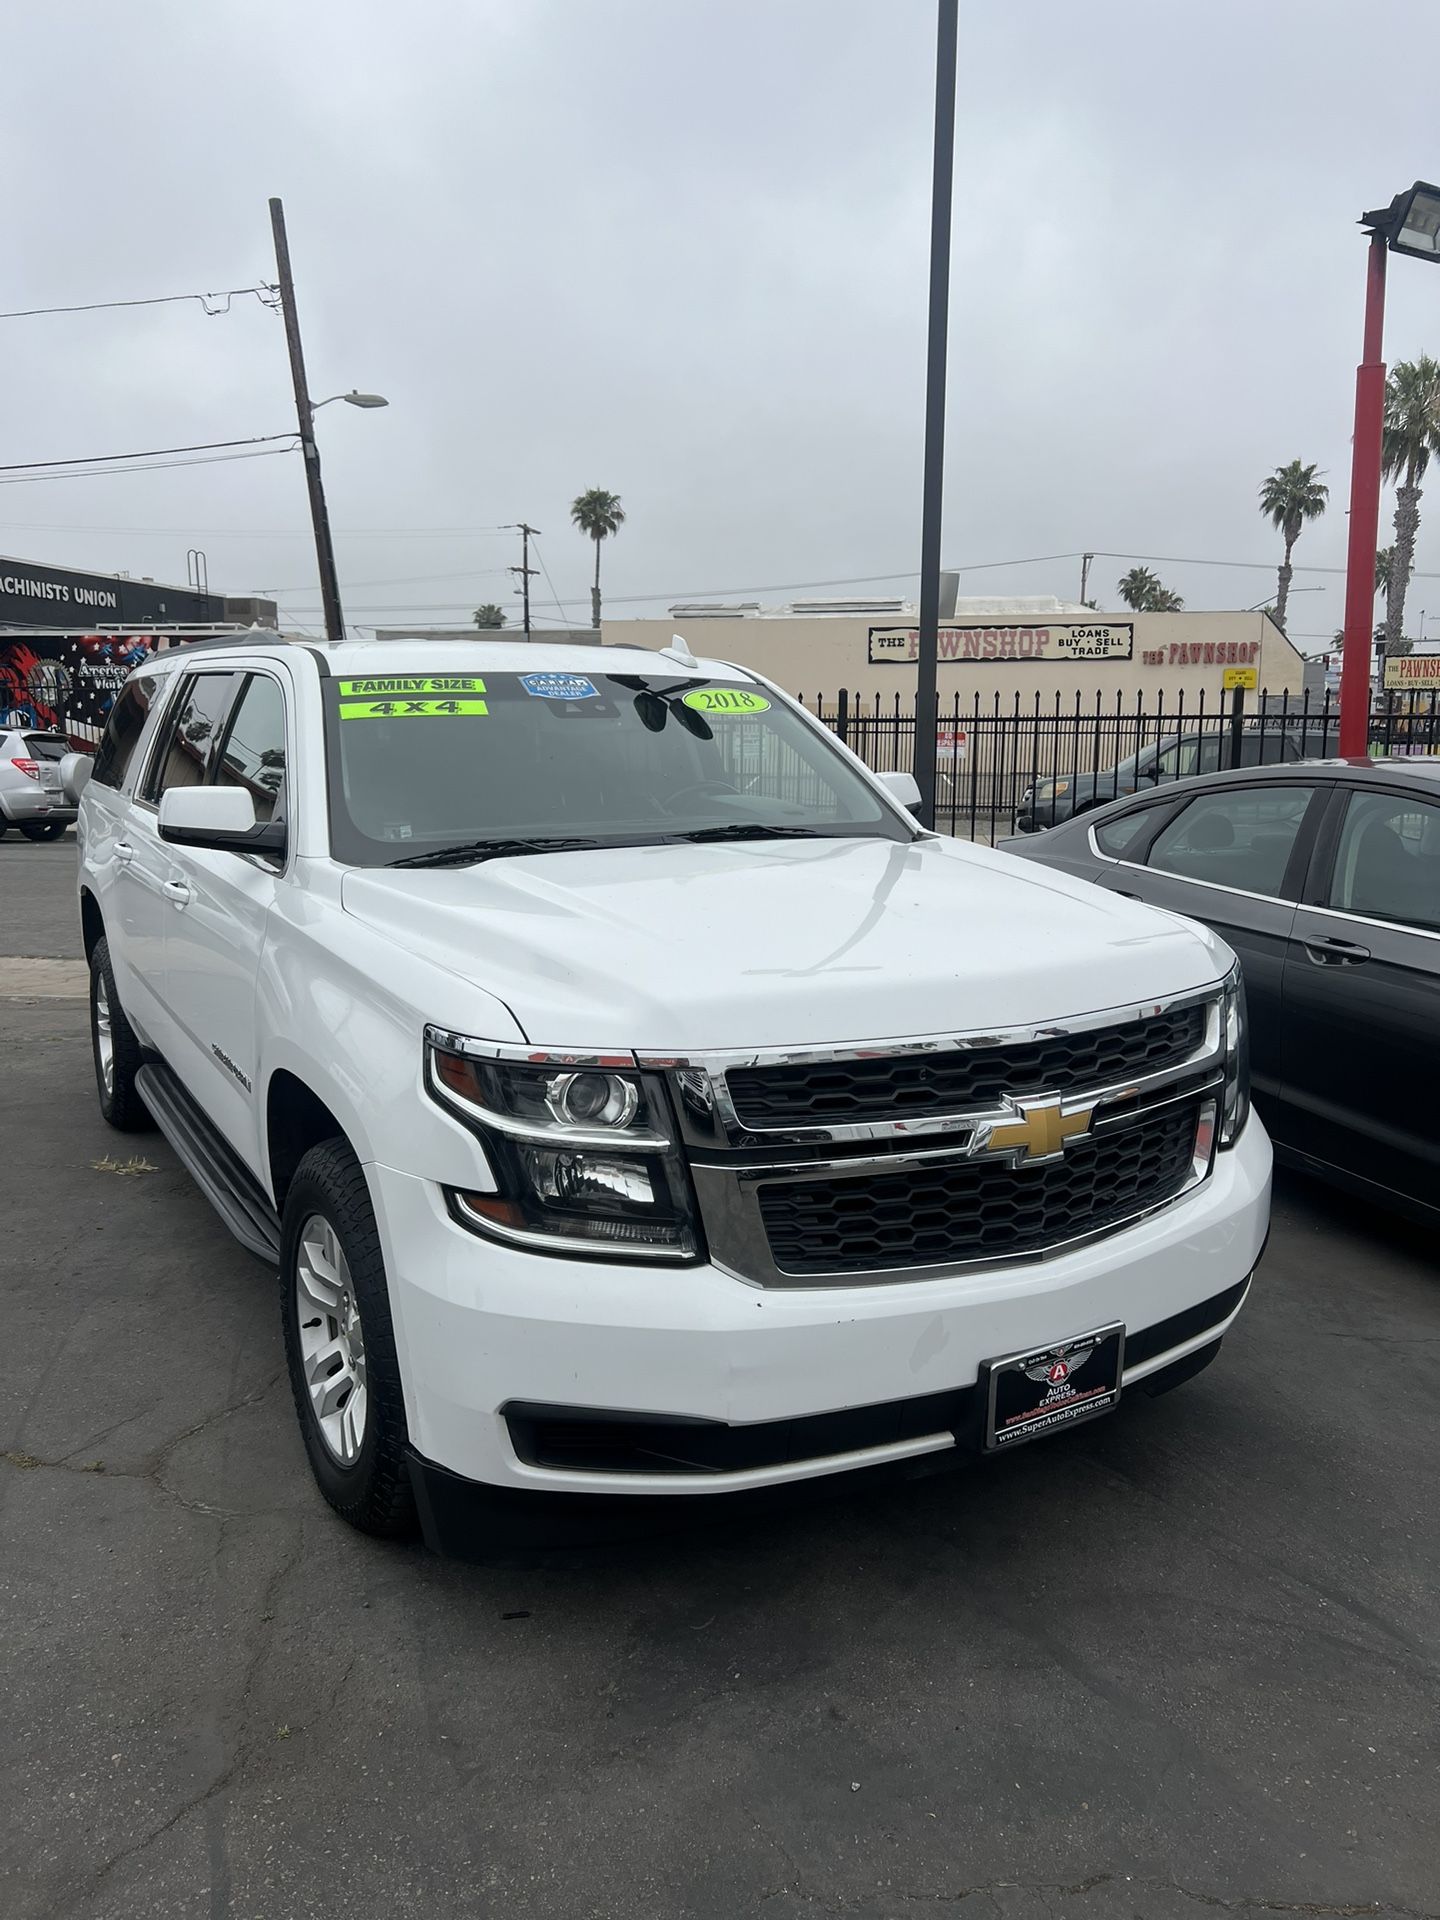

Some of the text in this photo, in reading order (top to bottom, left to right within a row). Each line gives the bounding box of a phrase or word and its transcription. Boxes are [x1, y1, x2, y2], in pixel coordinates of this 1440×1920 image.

[74, 587, 117, 608] UNION
[1072, 629, 1110, 638] LOANS
[878, 630, 1050, 658] THE PWNSHOP
[1058, 638, 1123, 647] BUY SELL
[1072, 647, 1109, 655] TRADE
[1142, 642, 1259, 665] THE PAWNSHOP
[80, 664, 128, 676] America
[352, 679, 476, 693] FAMILY SIZE
[699, 692, 755, 709] 2018
[1046, 1383, 1071, 1397] AUTO
[1039, 1389, 1077, 1407] EXPRESS
[998, 1396, 1111, 1443] www.SuperAutoExpress.com
